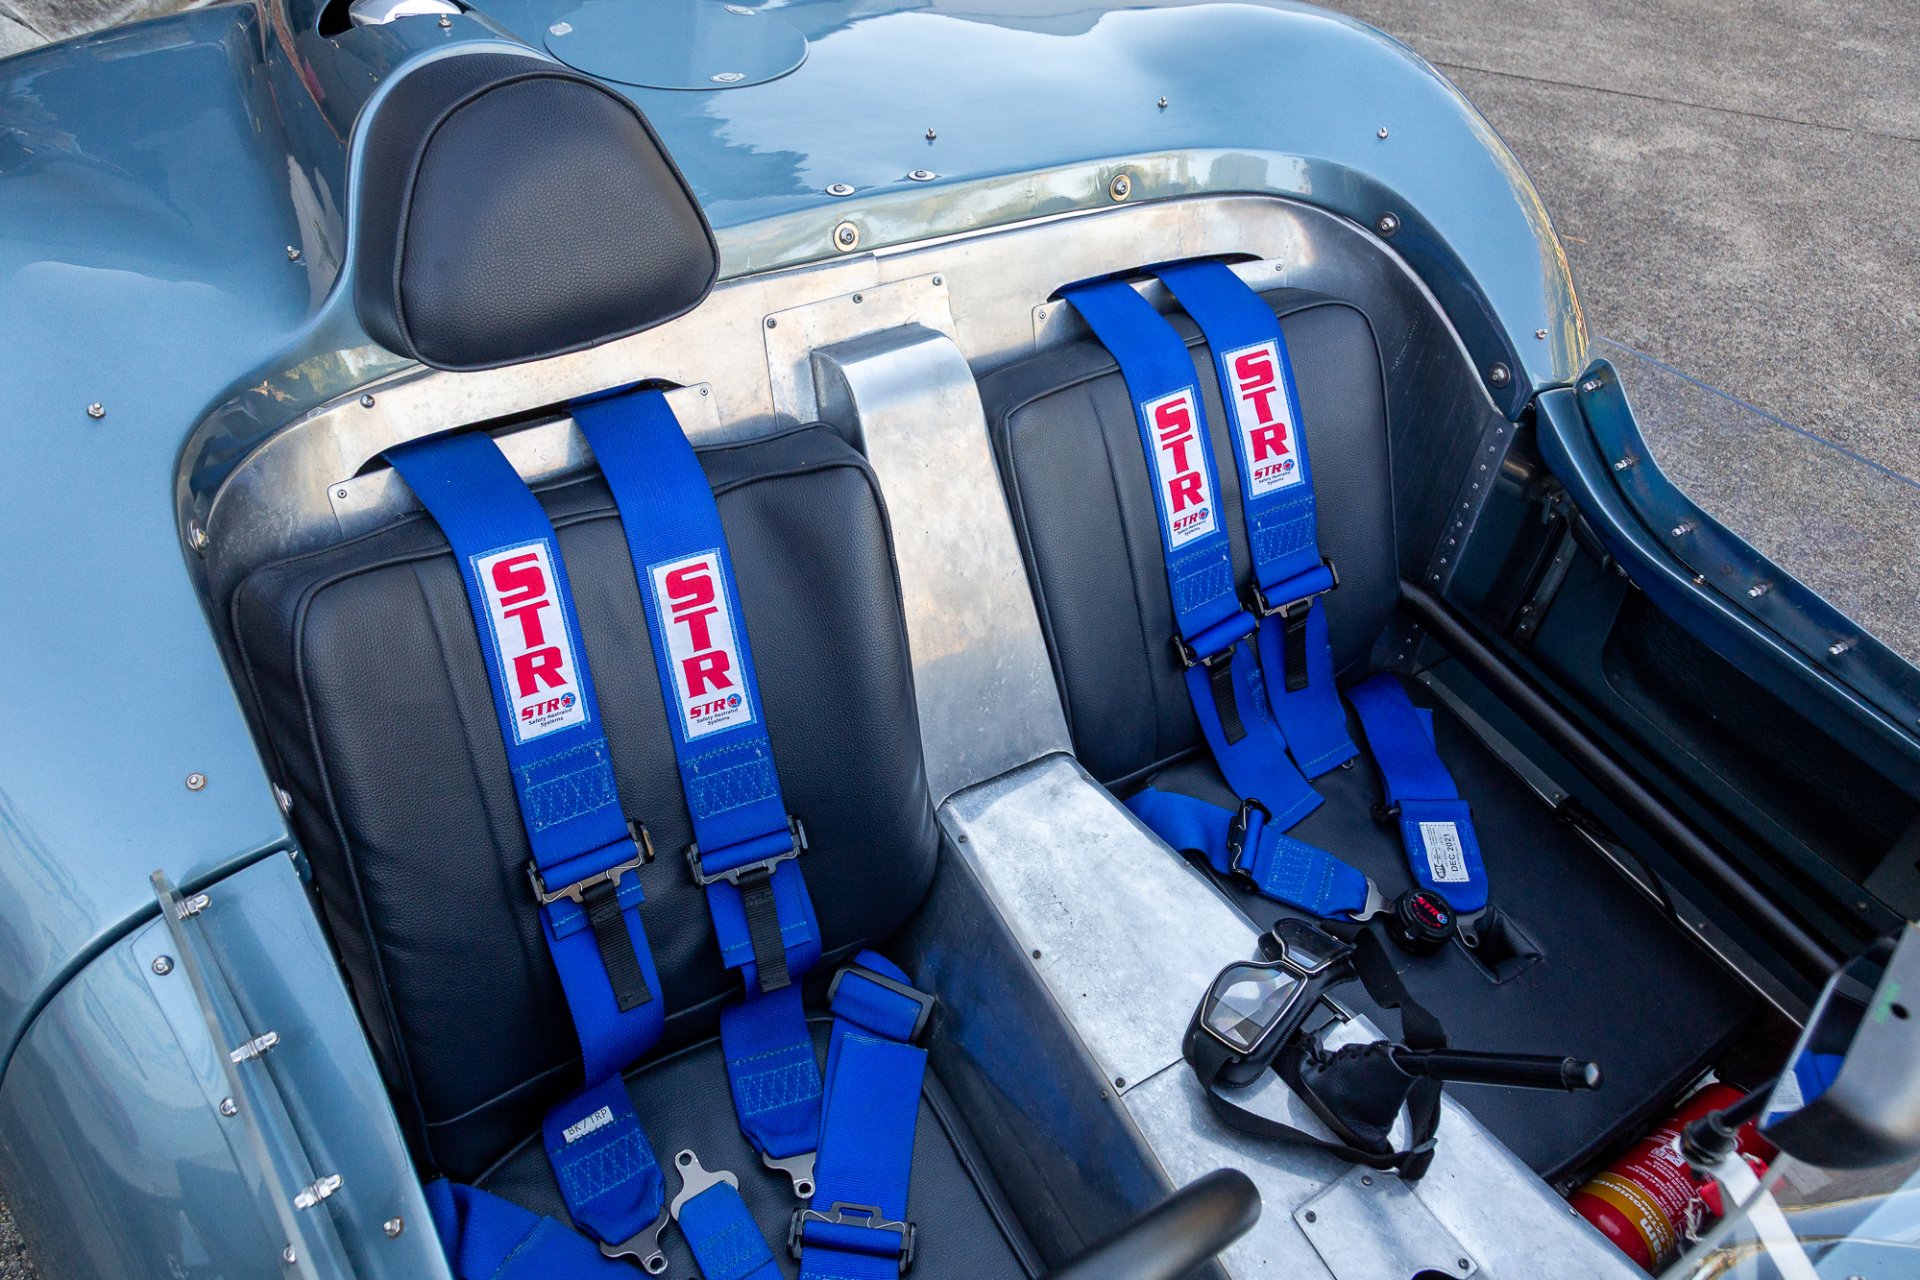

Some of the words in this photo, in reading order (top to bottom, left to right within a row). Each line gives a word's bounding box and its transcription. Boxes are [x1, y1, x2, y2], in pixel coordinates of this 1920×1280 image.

[1235, 349, 1290, 462] STR
[1155, 397, 1205, 514] STR
[1254, 463, 1282, 480] STR
[1173, 512, 1198, 531] STR
[492, 553, 568, 698] STR
[665, 562, 734, 698] STR
[521, 697, 560, 721] STR
[690, 698, 726, 719] STR
[1444, 833, 1454, 851] 2021
[1449, 854, 1458, 872] DEC
[1416, 896, 1439, 916] STR
[1616, 1183, 1641, 1200] SPRAY
